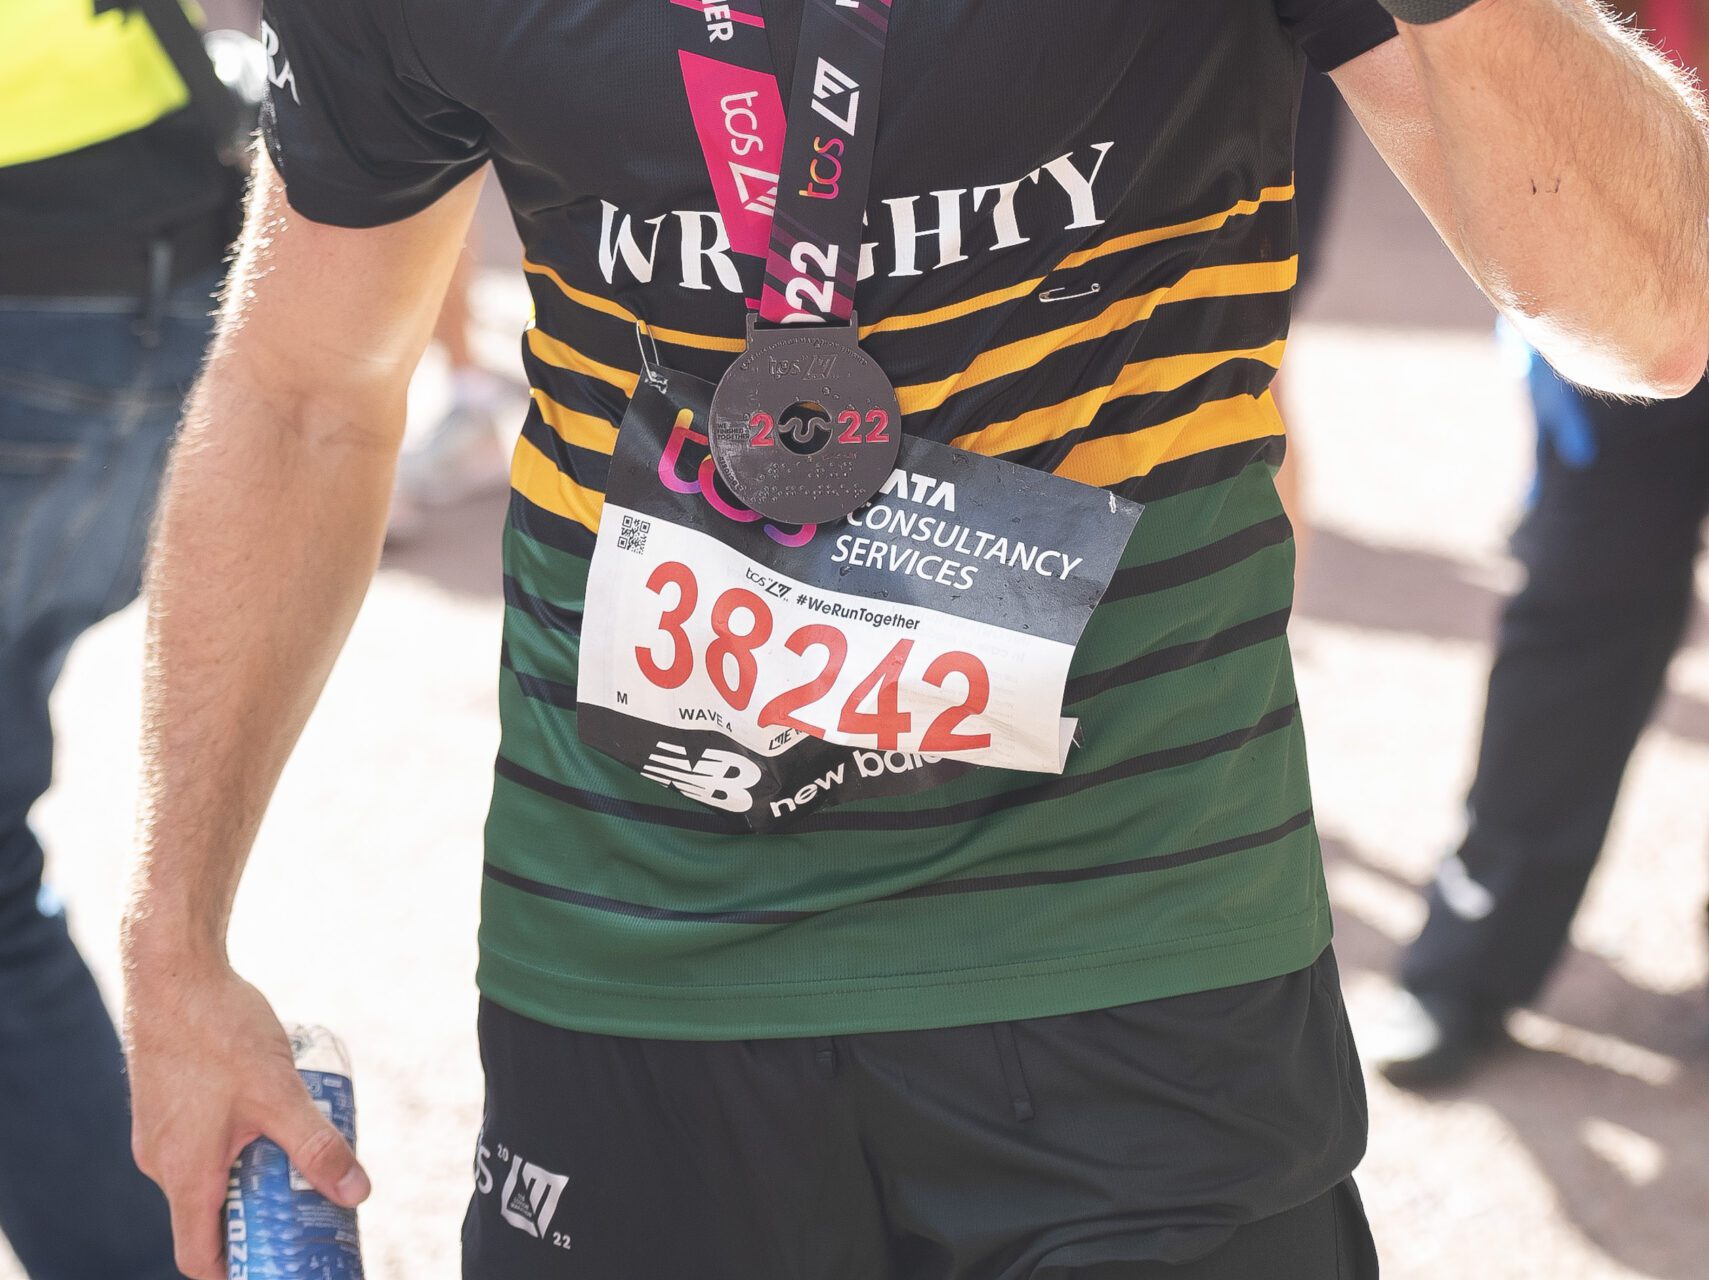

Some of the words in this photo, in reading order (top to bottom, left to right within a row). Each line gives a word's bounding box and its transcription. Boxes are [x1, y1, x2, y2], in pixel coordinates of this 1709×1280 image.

[720, 90, 764, 156] tcs
[798, 136, 845, 200] tcs
[598, 140, 1115, 294] WRHTY
[879, 468, 956, 512] ATA
[745, 567, 767, 587] tcs
[830, 534, 979, 590] SERVICES
[796, 593, 921, 630] #WeRunTogether
[634, 560, 991, 753] 38242
[616, 691, 629, 705] M
[678, 707, 724, 727] WAVE
[769, 762, 845, 818] new
[552, 1231, 572, 1250] 22
